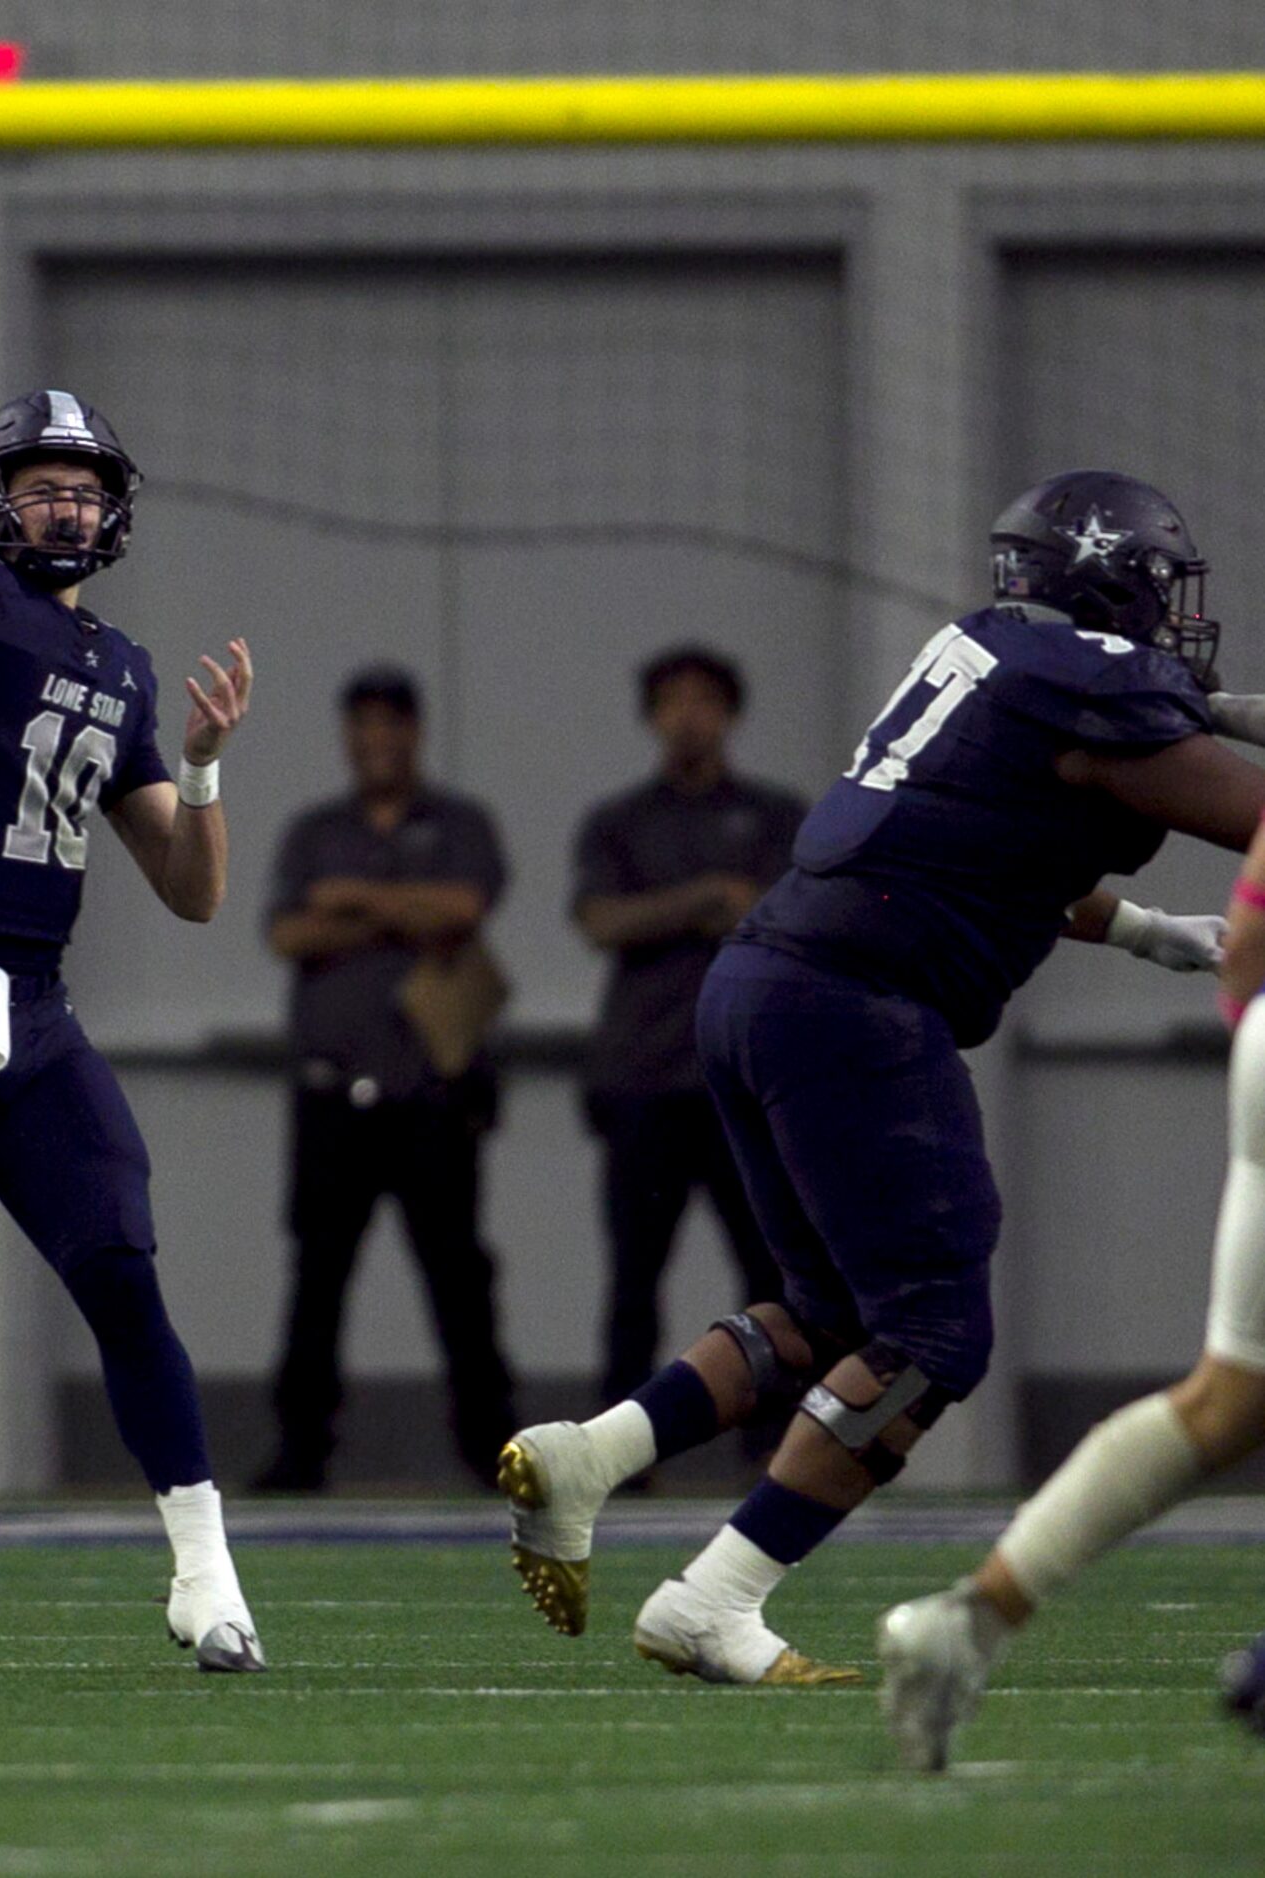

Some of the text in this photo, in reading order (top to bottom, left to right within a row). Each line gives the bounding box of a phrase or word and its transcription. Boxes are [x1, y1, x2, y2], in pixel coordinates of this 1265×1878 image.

[42, 674, 126, 727] LONE STAR
[3, 712, 116, 868] 10
